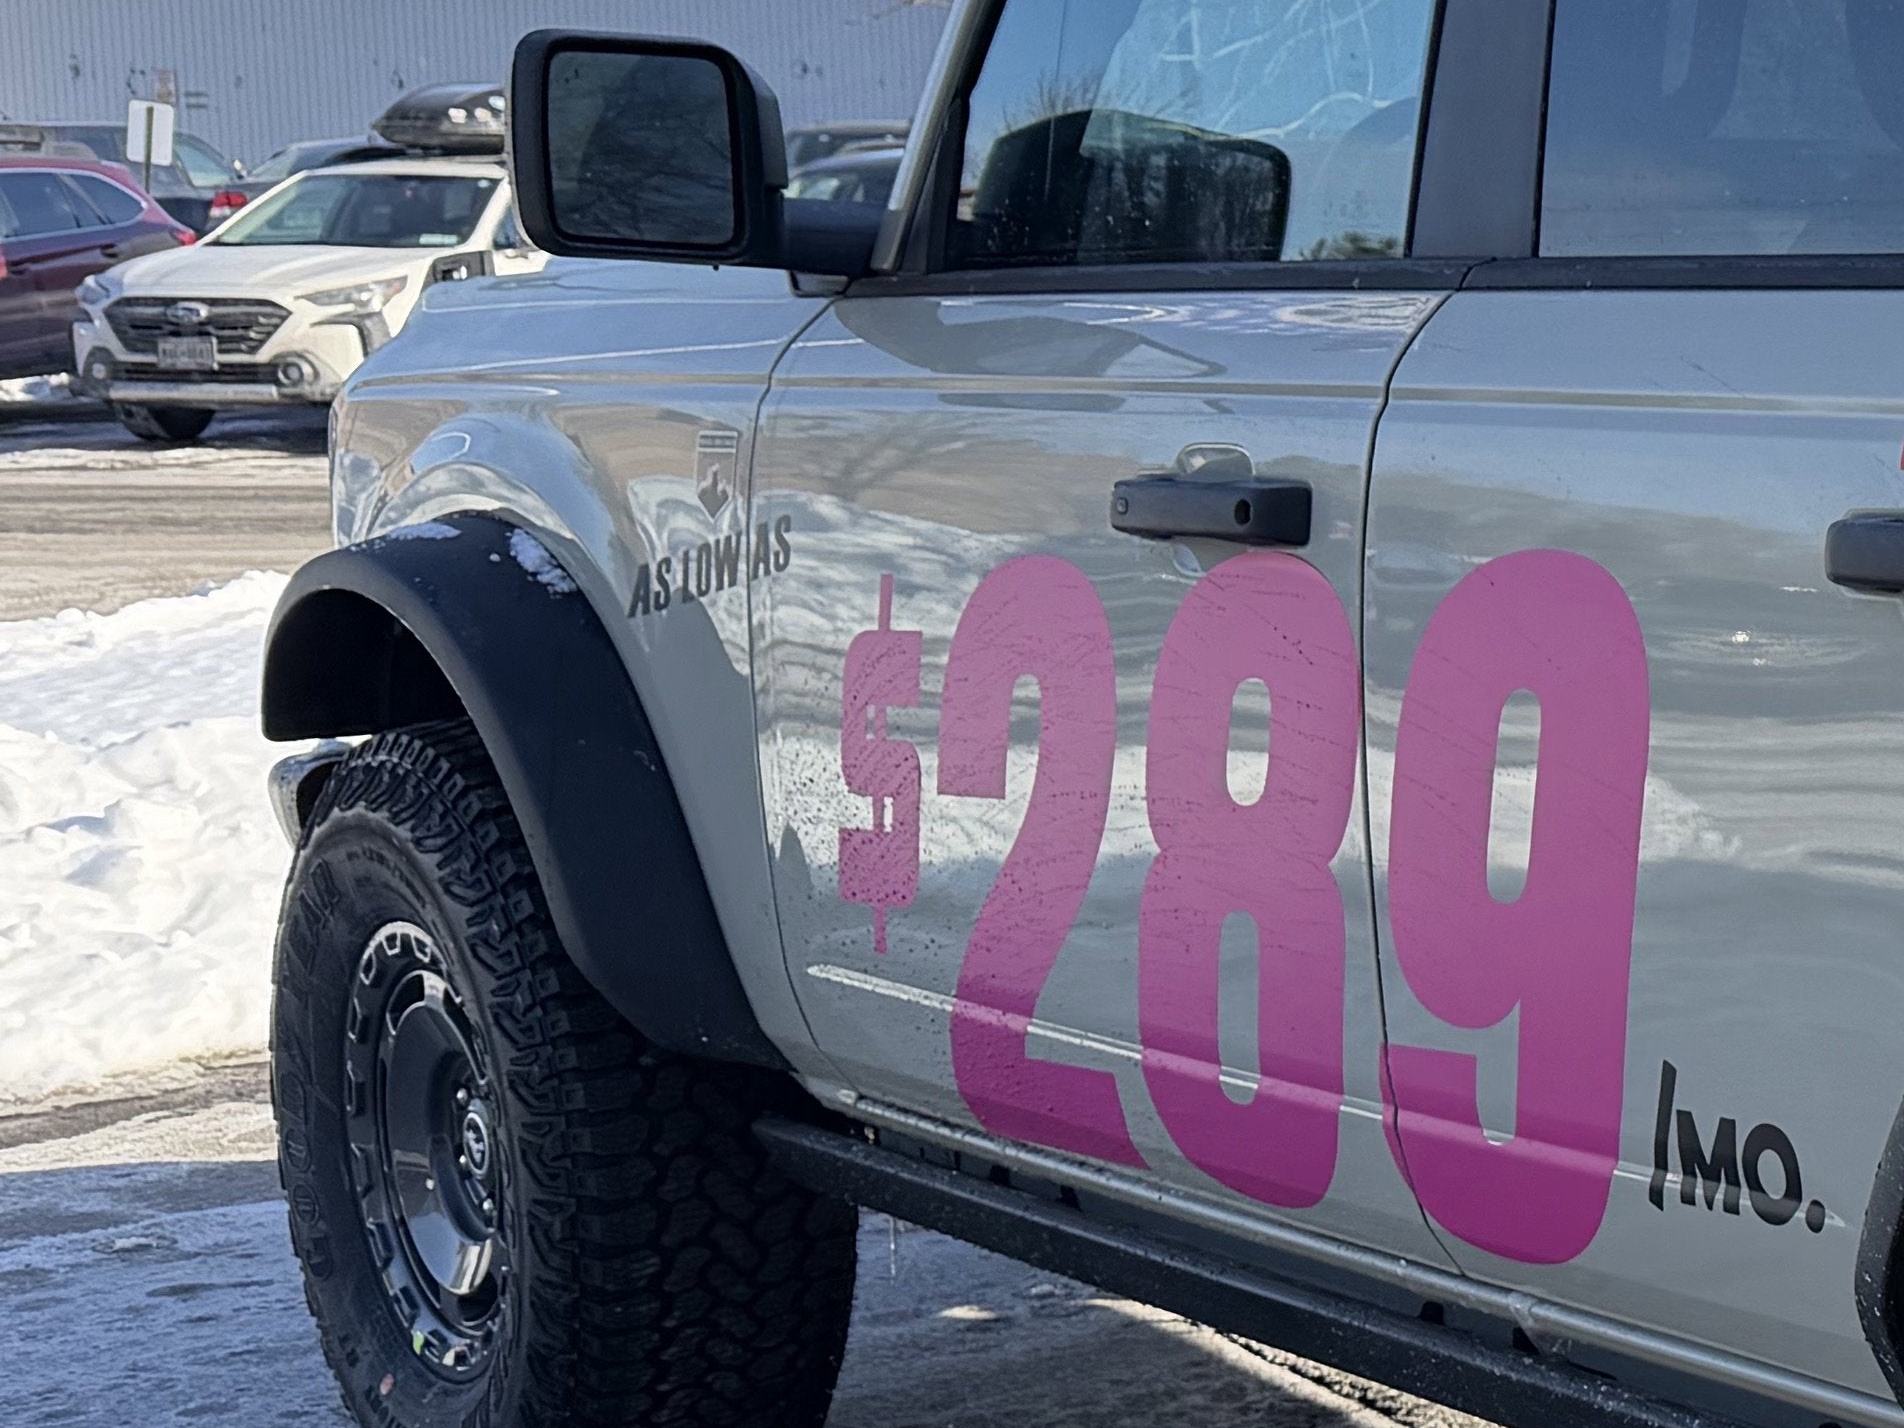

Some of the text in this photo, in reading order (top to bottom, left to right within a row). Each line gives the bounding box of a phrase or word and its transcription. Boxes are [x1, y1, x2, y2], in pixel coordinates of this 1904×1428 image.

[627, 514, 793, 619] AS LOW AS
[838, 549, 1828, 1267] $289 /MO.
